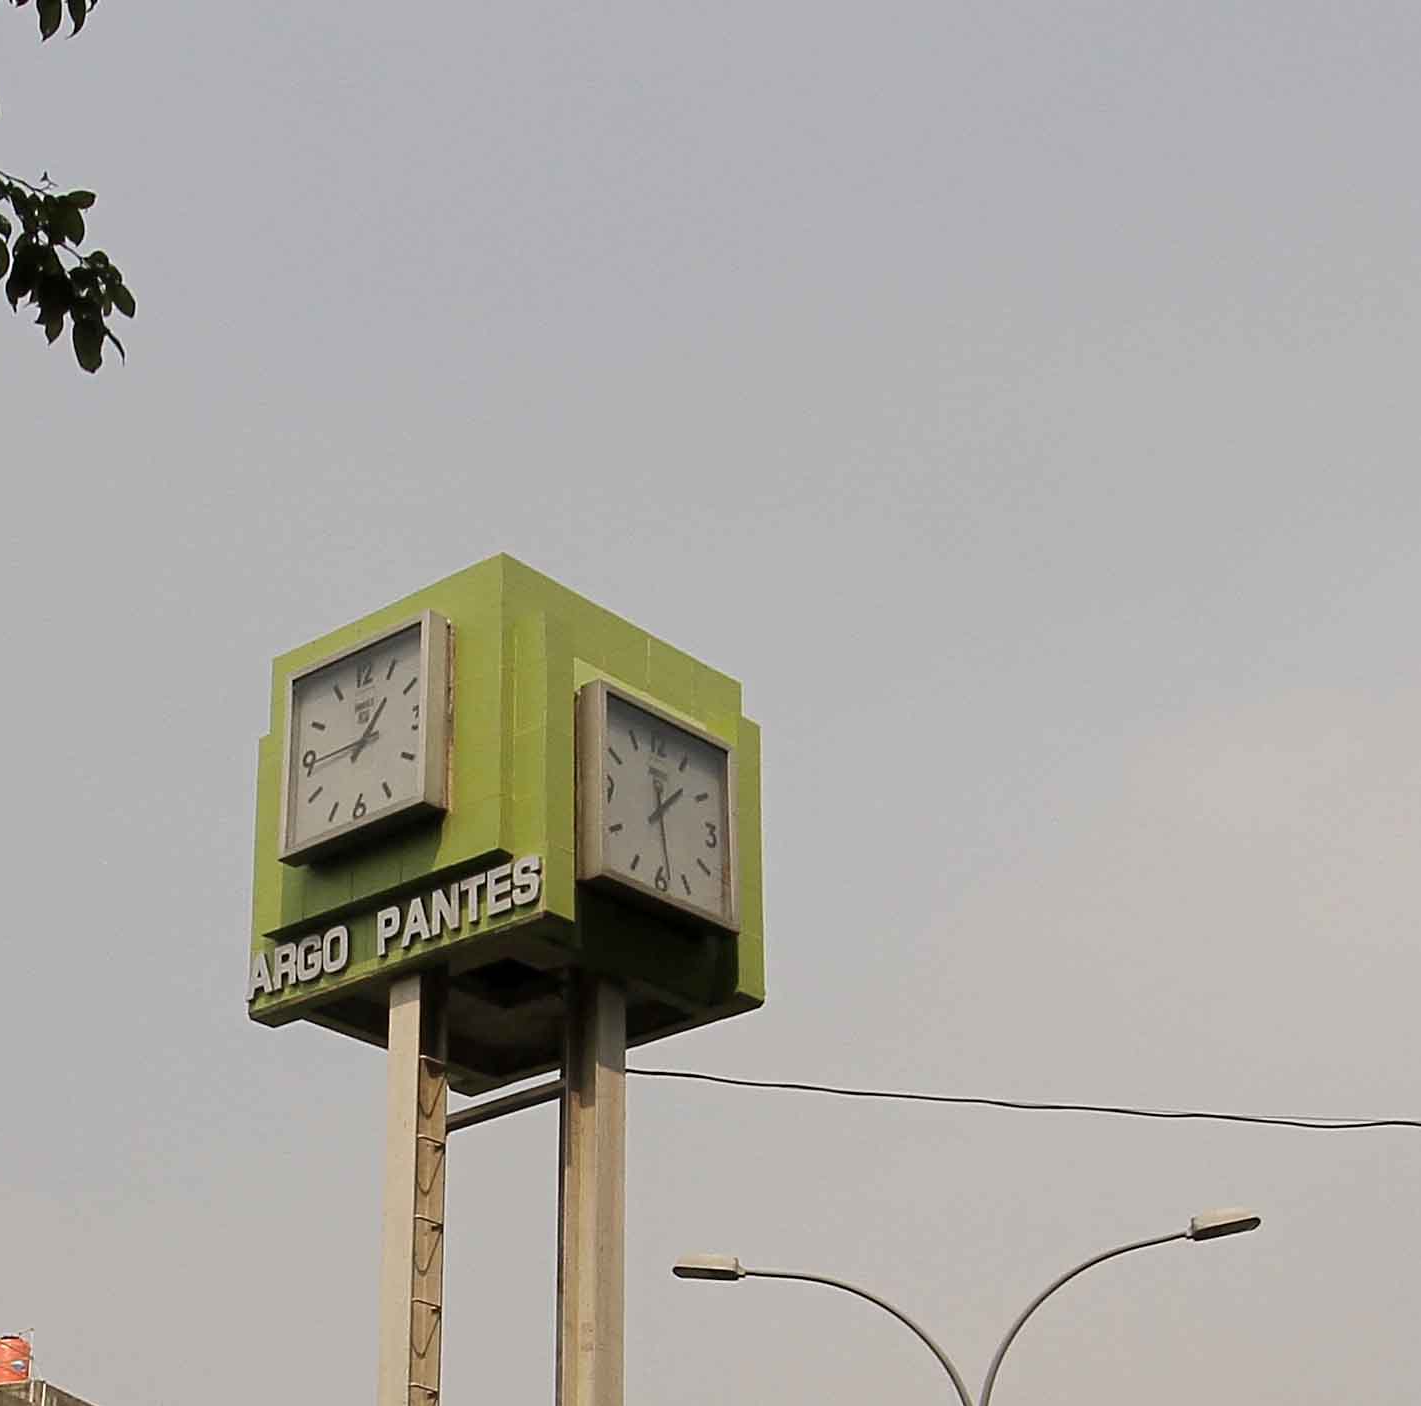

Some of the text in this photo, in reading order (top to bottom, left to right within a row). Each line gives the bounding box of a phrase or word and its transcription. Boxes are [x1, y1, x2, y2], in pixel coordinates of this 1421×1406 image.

[302, 750, 317, 778] 9
[352, 792, 367, 819] 6
[704, 822, 717, 849] 3
[246, 855, 543, 1000] ARGO PANTES
